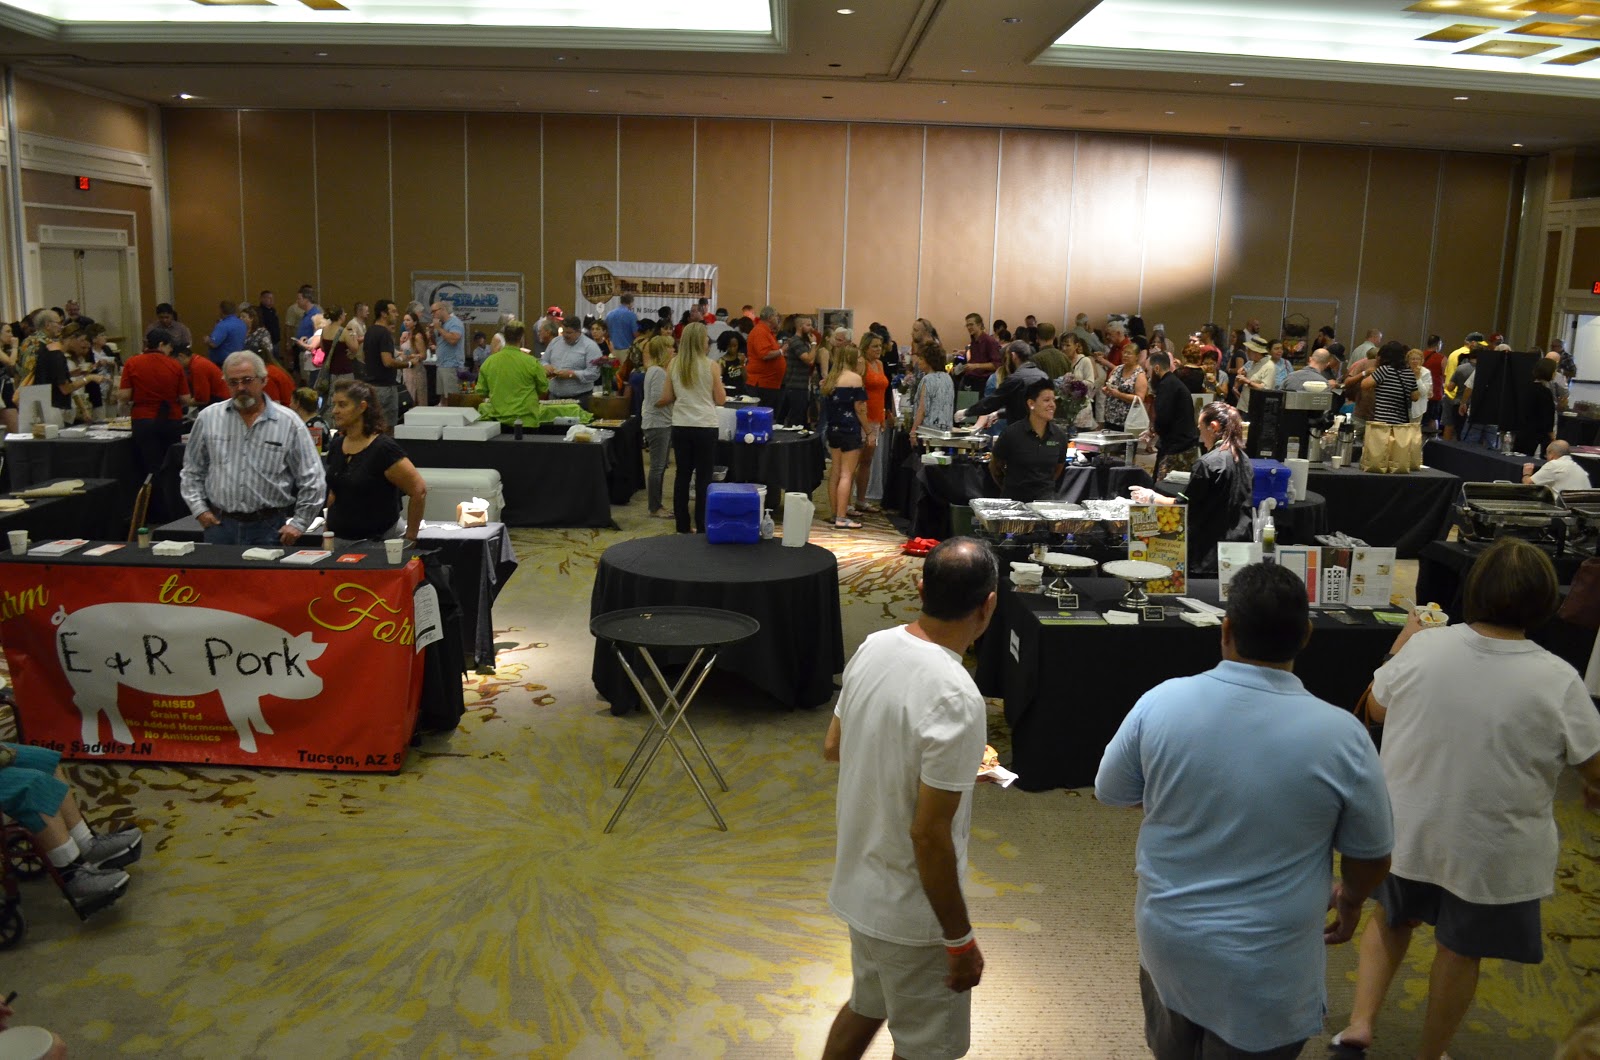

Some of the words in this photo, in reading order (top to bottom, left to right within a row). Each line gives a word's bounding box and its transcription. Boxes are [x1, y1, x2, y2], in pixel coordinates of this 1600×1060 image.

[641, 280, 675, 293] Bourbon
[688, 281, 706, 295] BBQ
[158, 574, 201, 604] to
[308, 583, 415, 646] For
[60, 631, 93, 674] E
[145, 635, 174, 676] R
[204, 637, 305, 678] Pork
[152, 699, 196, 709] RAISED
[150, 710, 180, 720] Grain
[182, 711, 203, 721] Fed
[126, 718, 141, 728] No
[143, 720, 176, 730] Added
[178, 722, 236, 732] Hormones
[144, 730, 161, 740] No
[162, 731, 221, 742] Antibiotics
[71, 741, 125, 754] Saddle
[131, 743, 153, 755] LN
[297, 750, 360, 767] Tucson,
[365, 754, 387, 766] AZ
